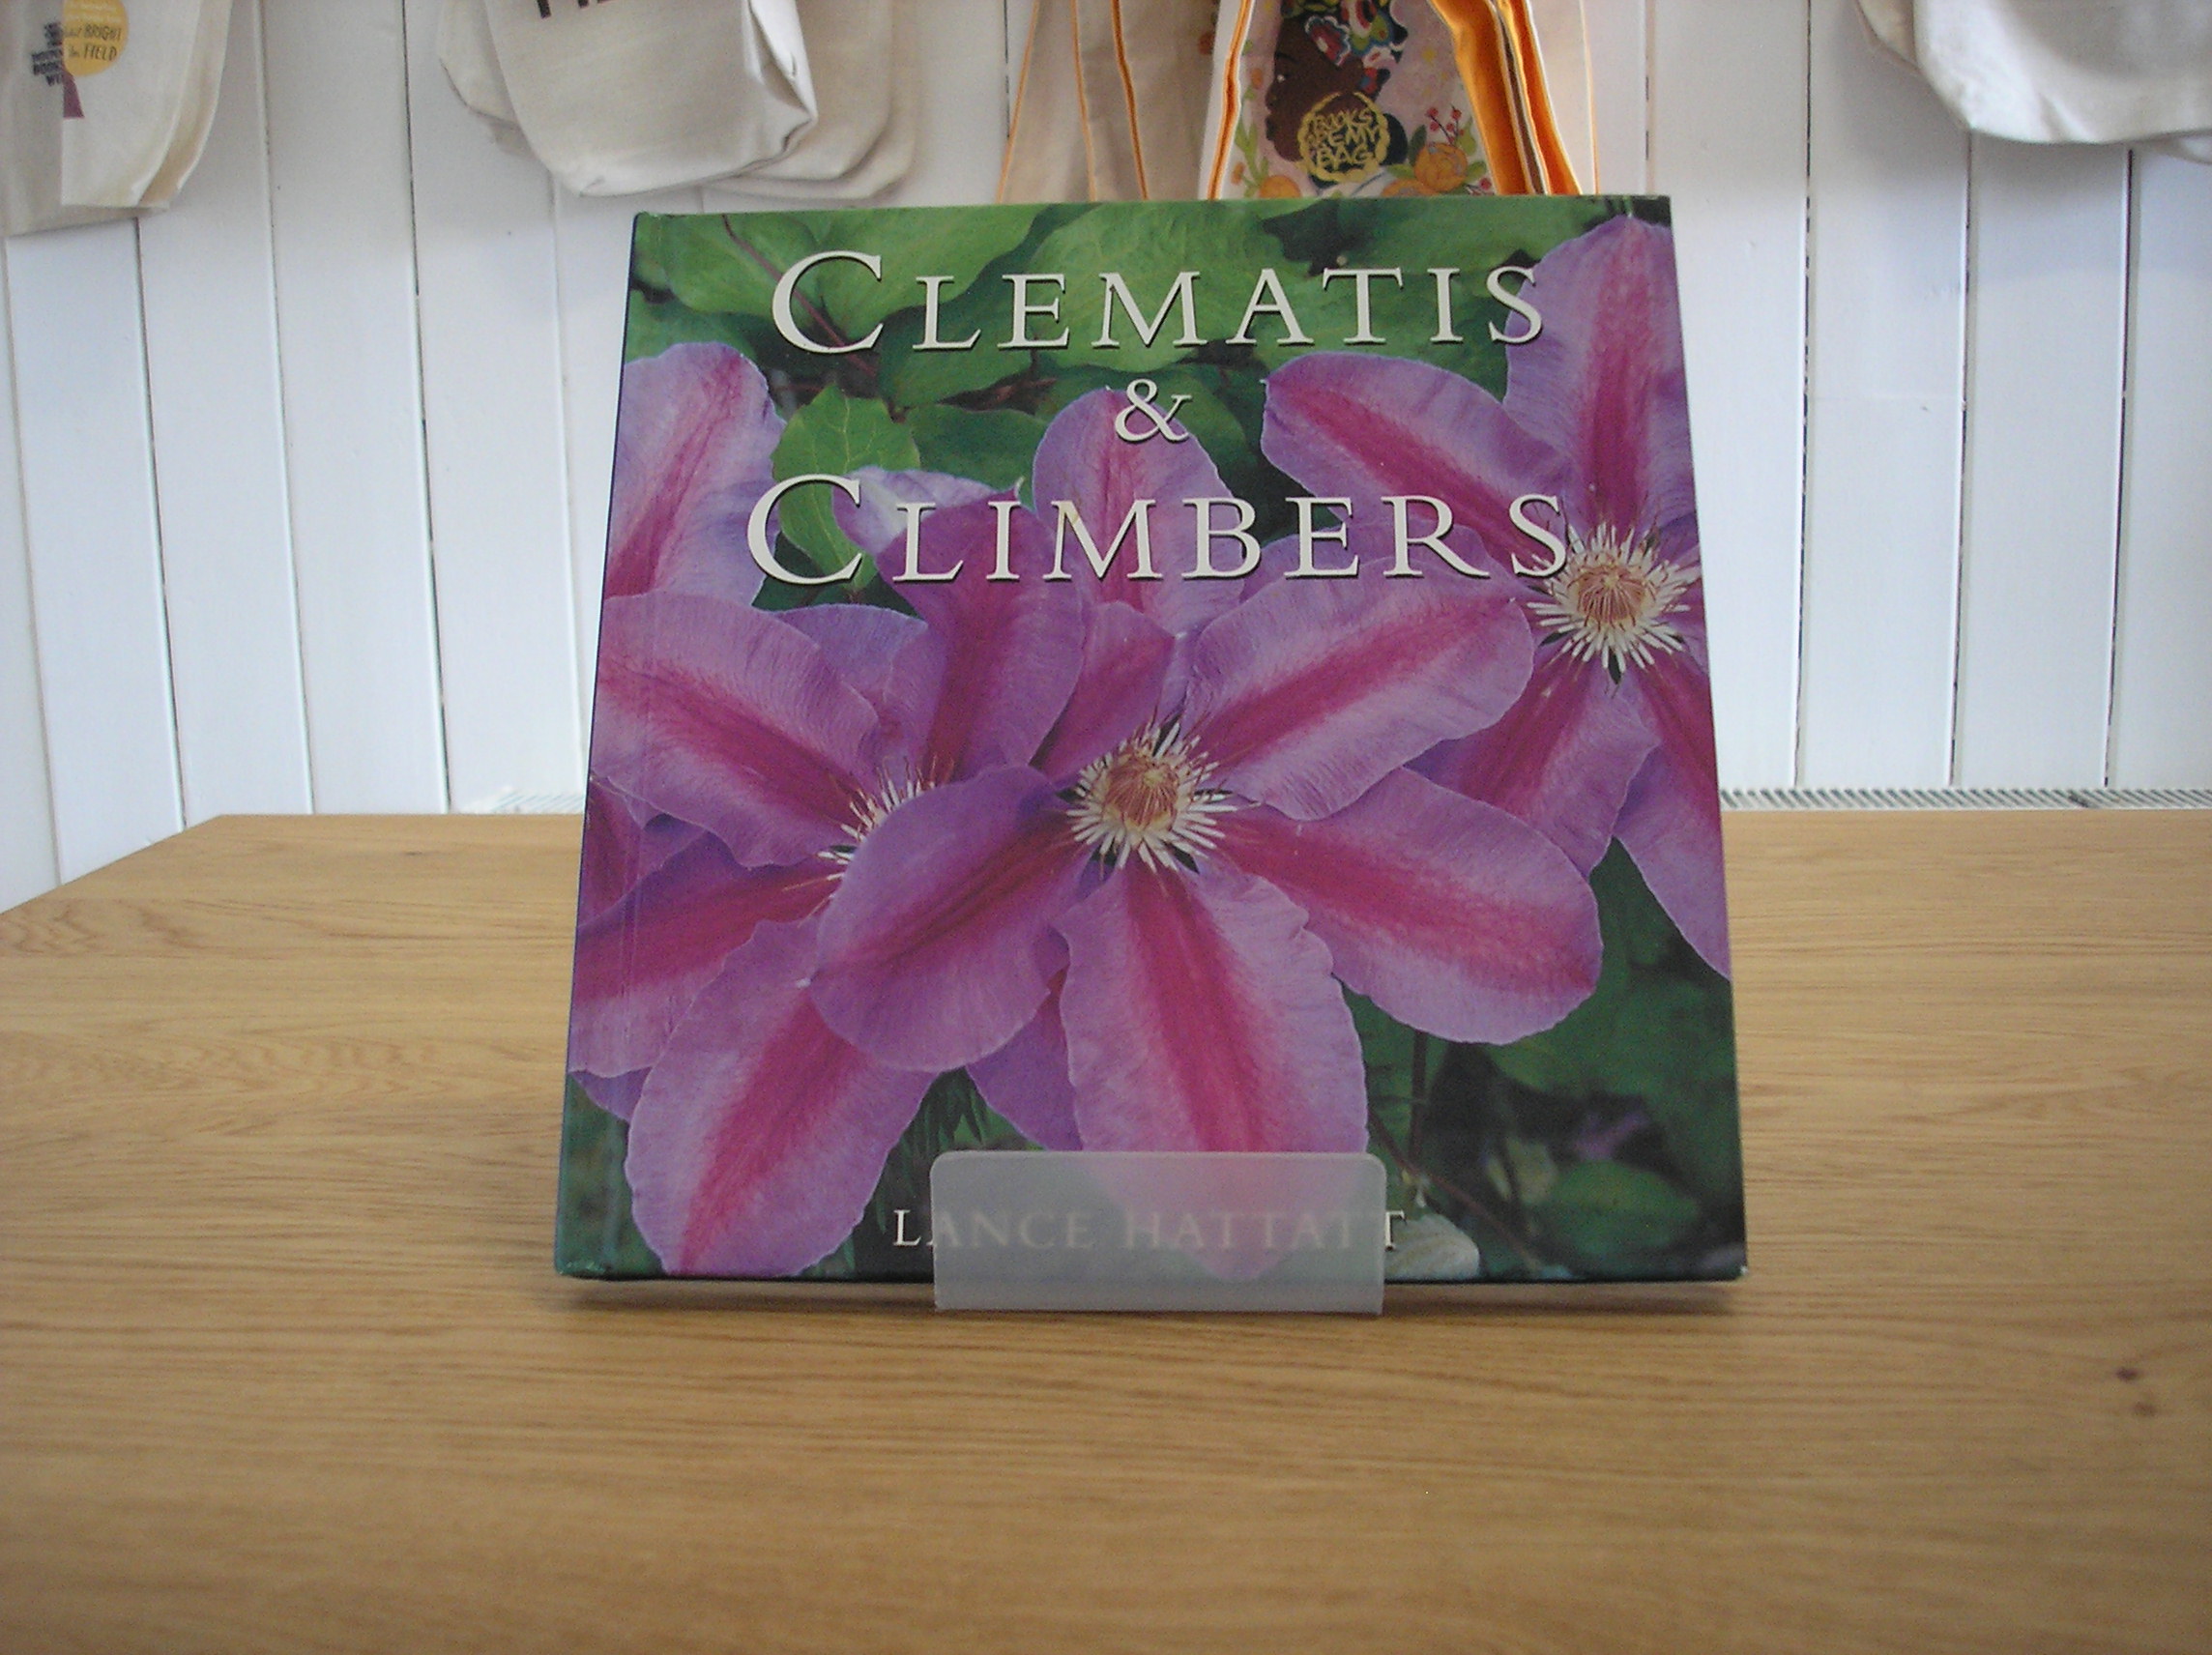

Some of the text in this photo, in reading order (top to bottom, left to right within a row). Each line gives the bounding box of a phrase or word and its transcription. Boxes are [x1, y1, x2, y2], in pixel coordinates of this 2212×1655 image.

[83, 44, 118, 62] FIELD
[1316, 144, 1374, 171] BAG
[771, 249, 1545, 355] CLEMATIS
[1113, 377, 1193, 443] &
[745, 472, 1568, 585] CLIMBERS
[892, 1208, 1092, 1248] LANCE
